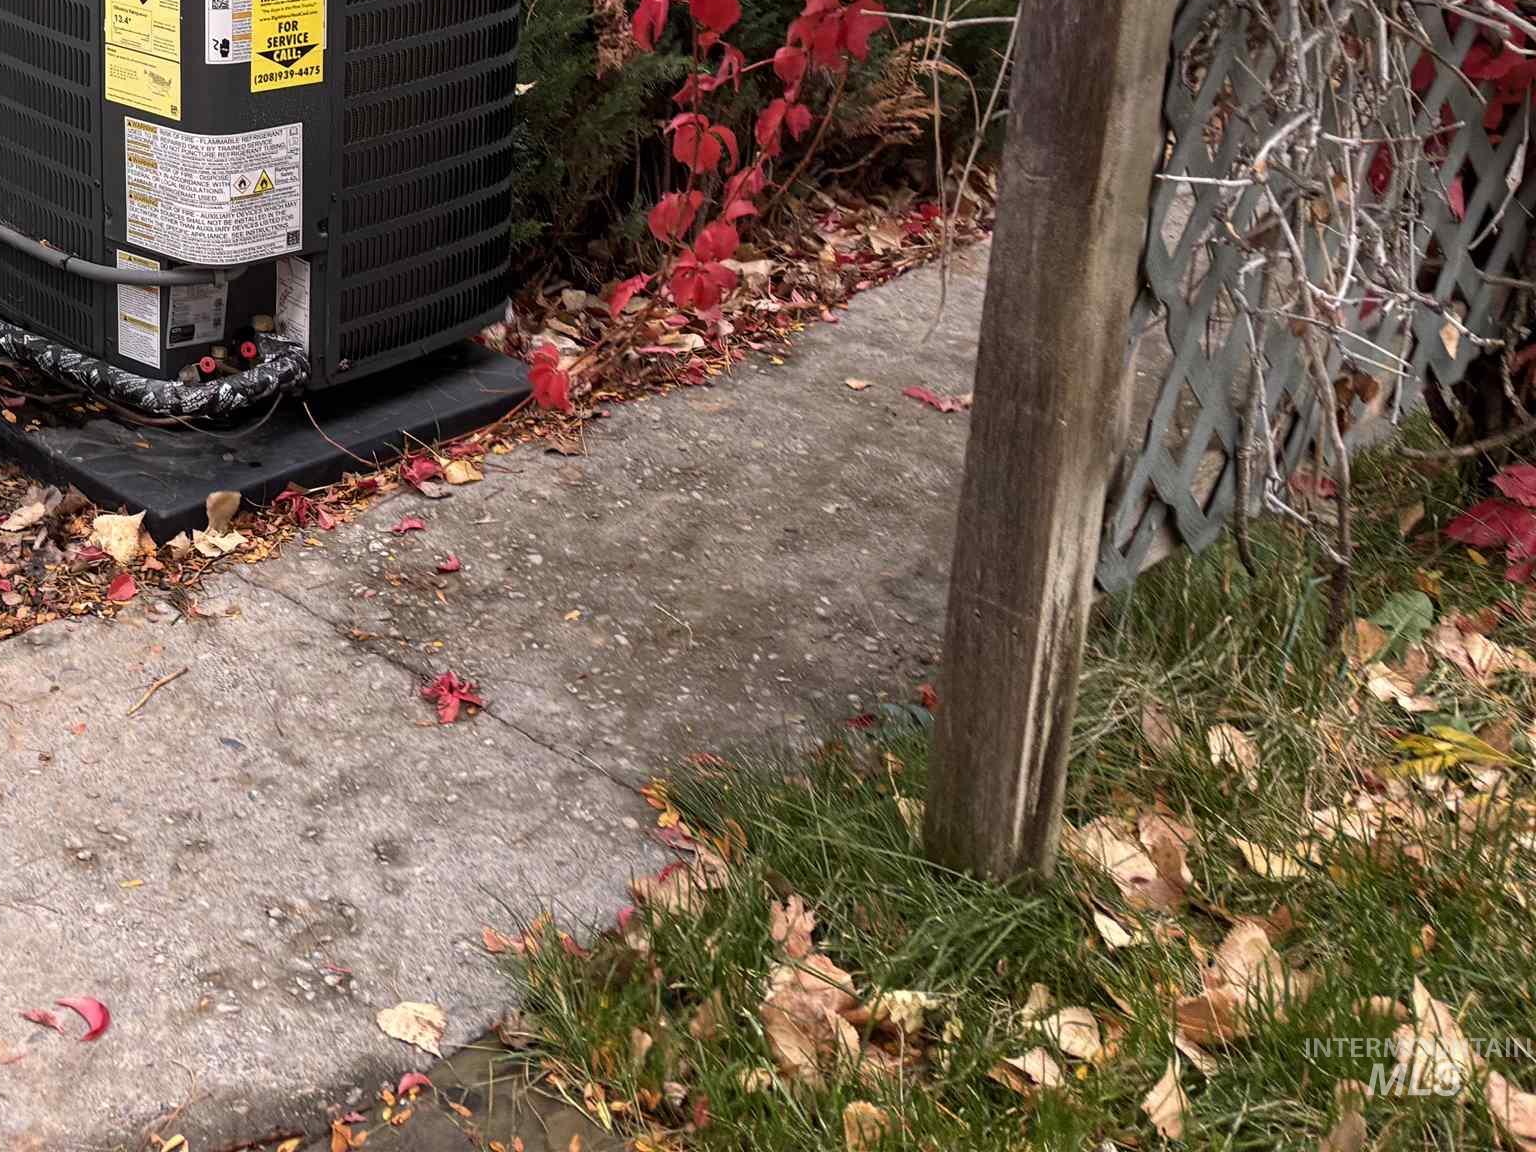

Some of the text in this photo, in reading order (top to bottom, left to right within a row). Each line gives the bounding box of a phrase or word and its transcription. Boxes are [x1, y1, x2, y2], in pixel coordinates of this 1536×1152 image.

[278, 20, 298, 33] FOR
[267, 32, 309, 49] SERVICE
[273, 47, 301, 62] CALL:
[254, 65, 321, 86] (208)939-4475
